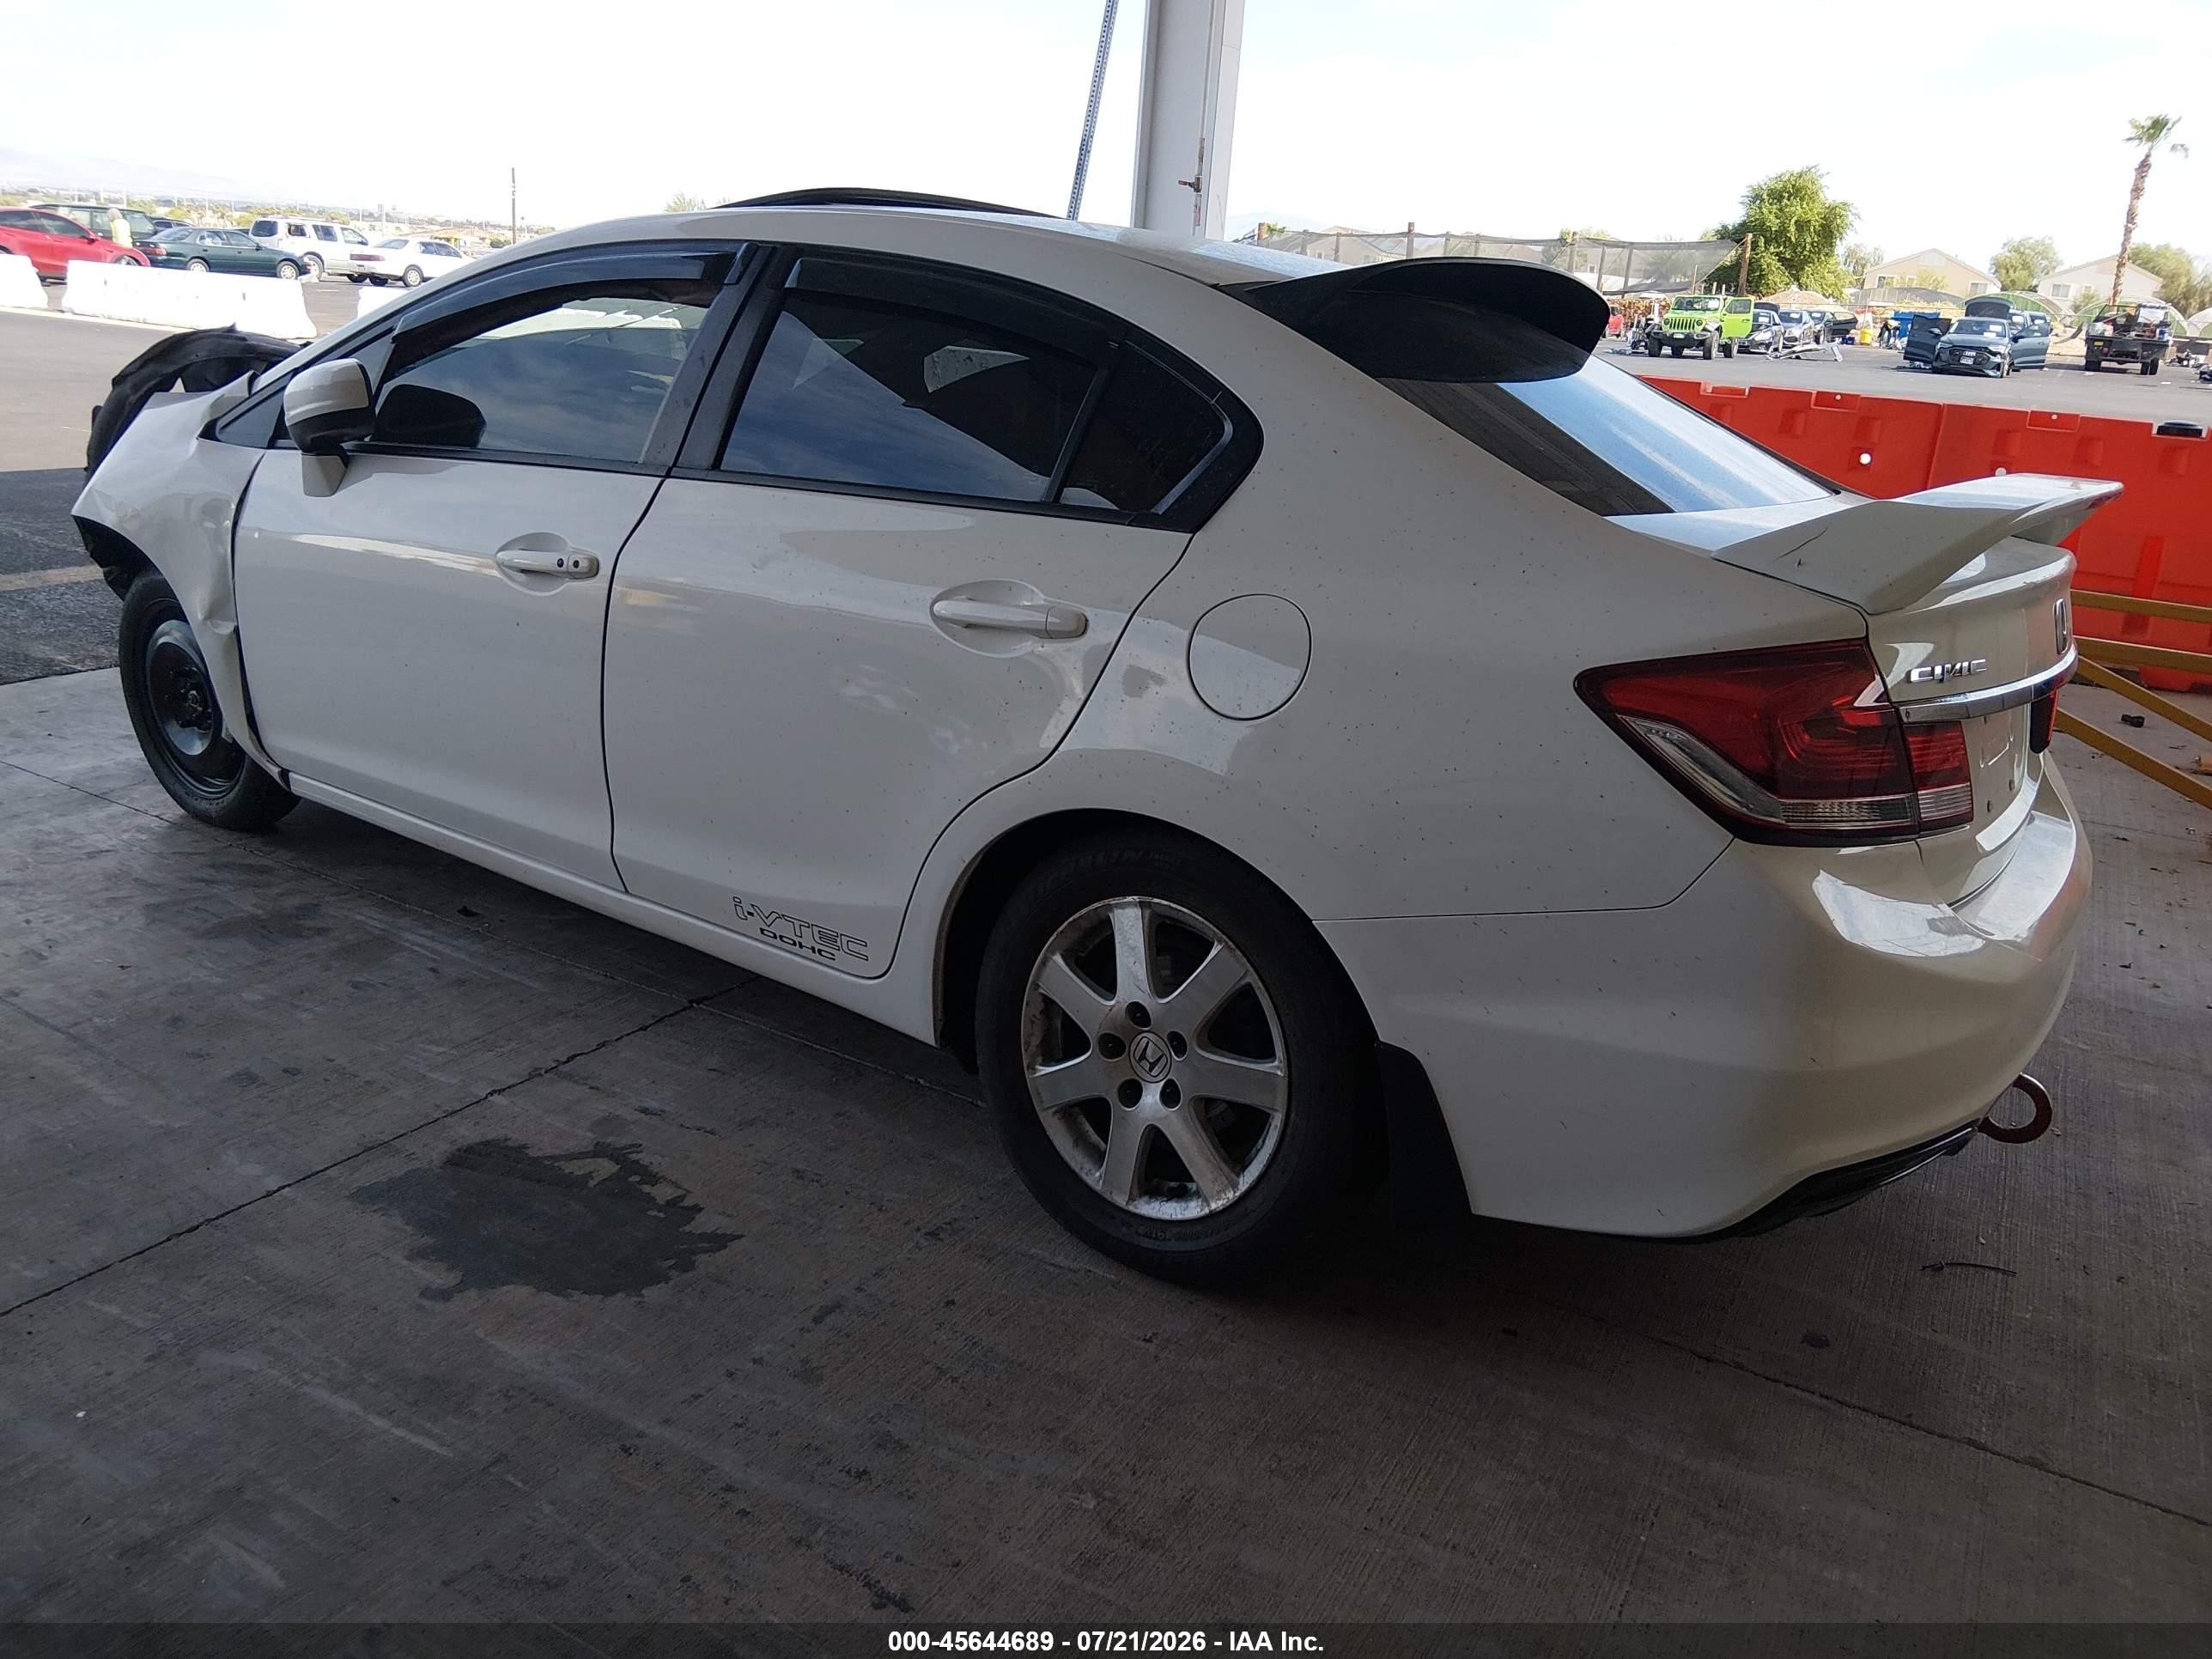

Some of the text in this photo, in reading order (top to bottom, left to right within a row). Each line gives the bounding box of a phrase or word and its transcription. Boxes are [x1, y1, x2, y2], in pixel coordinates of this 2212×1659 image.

[1909, 659, 1988, 683] CIVIC
[732, 896, 869, 962] i-VTEC
[759, 927, 836, 961] DOHC
